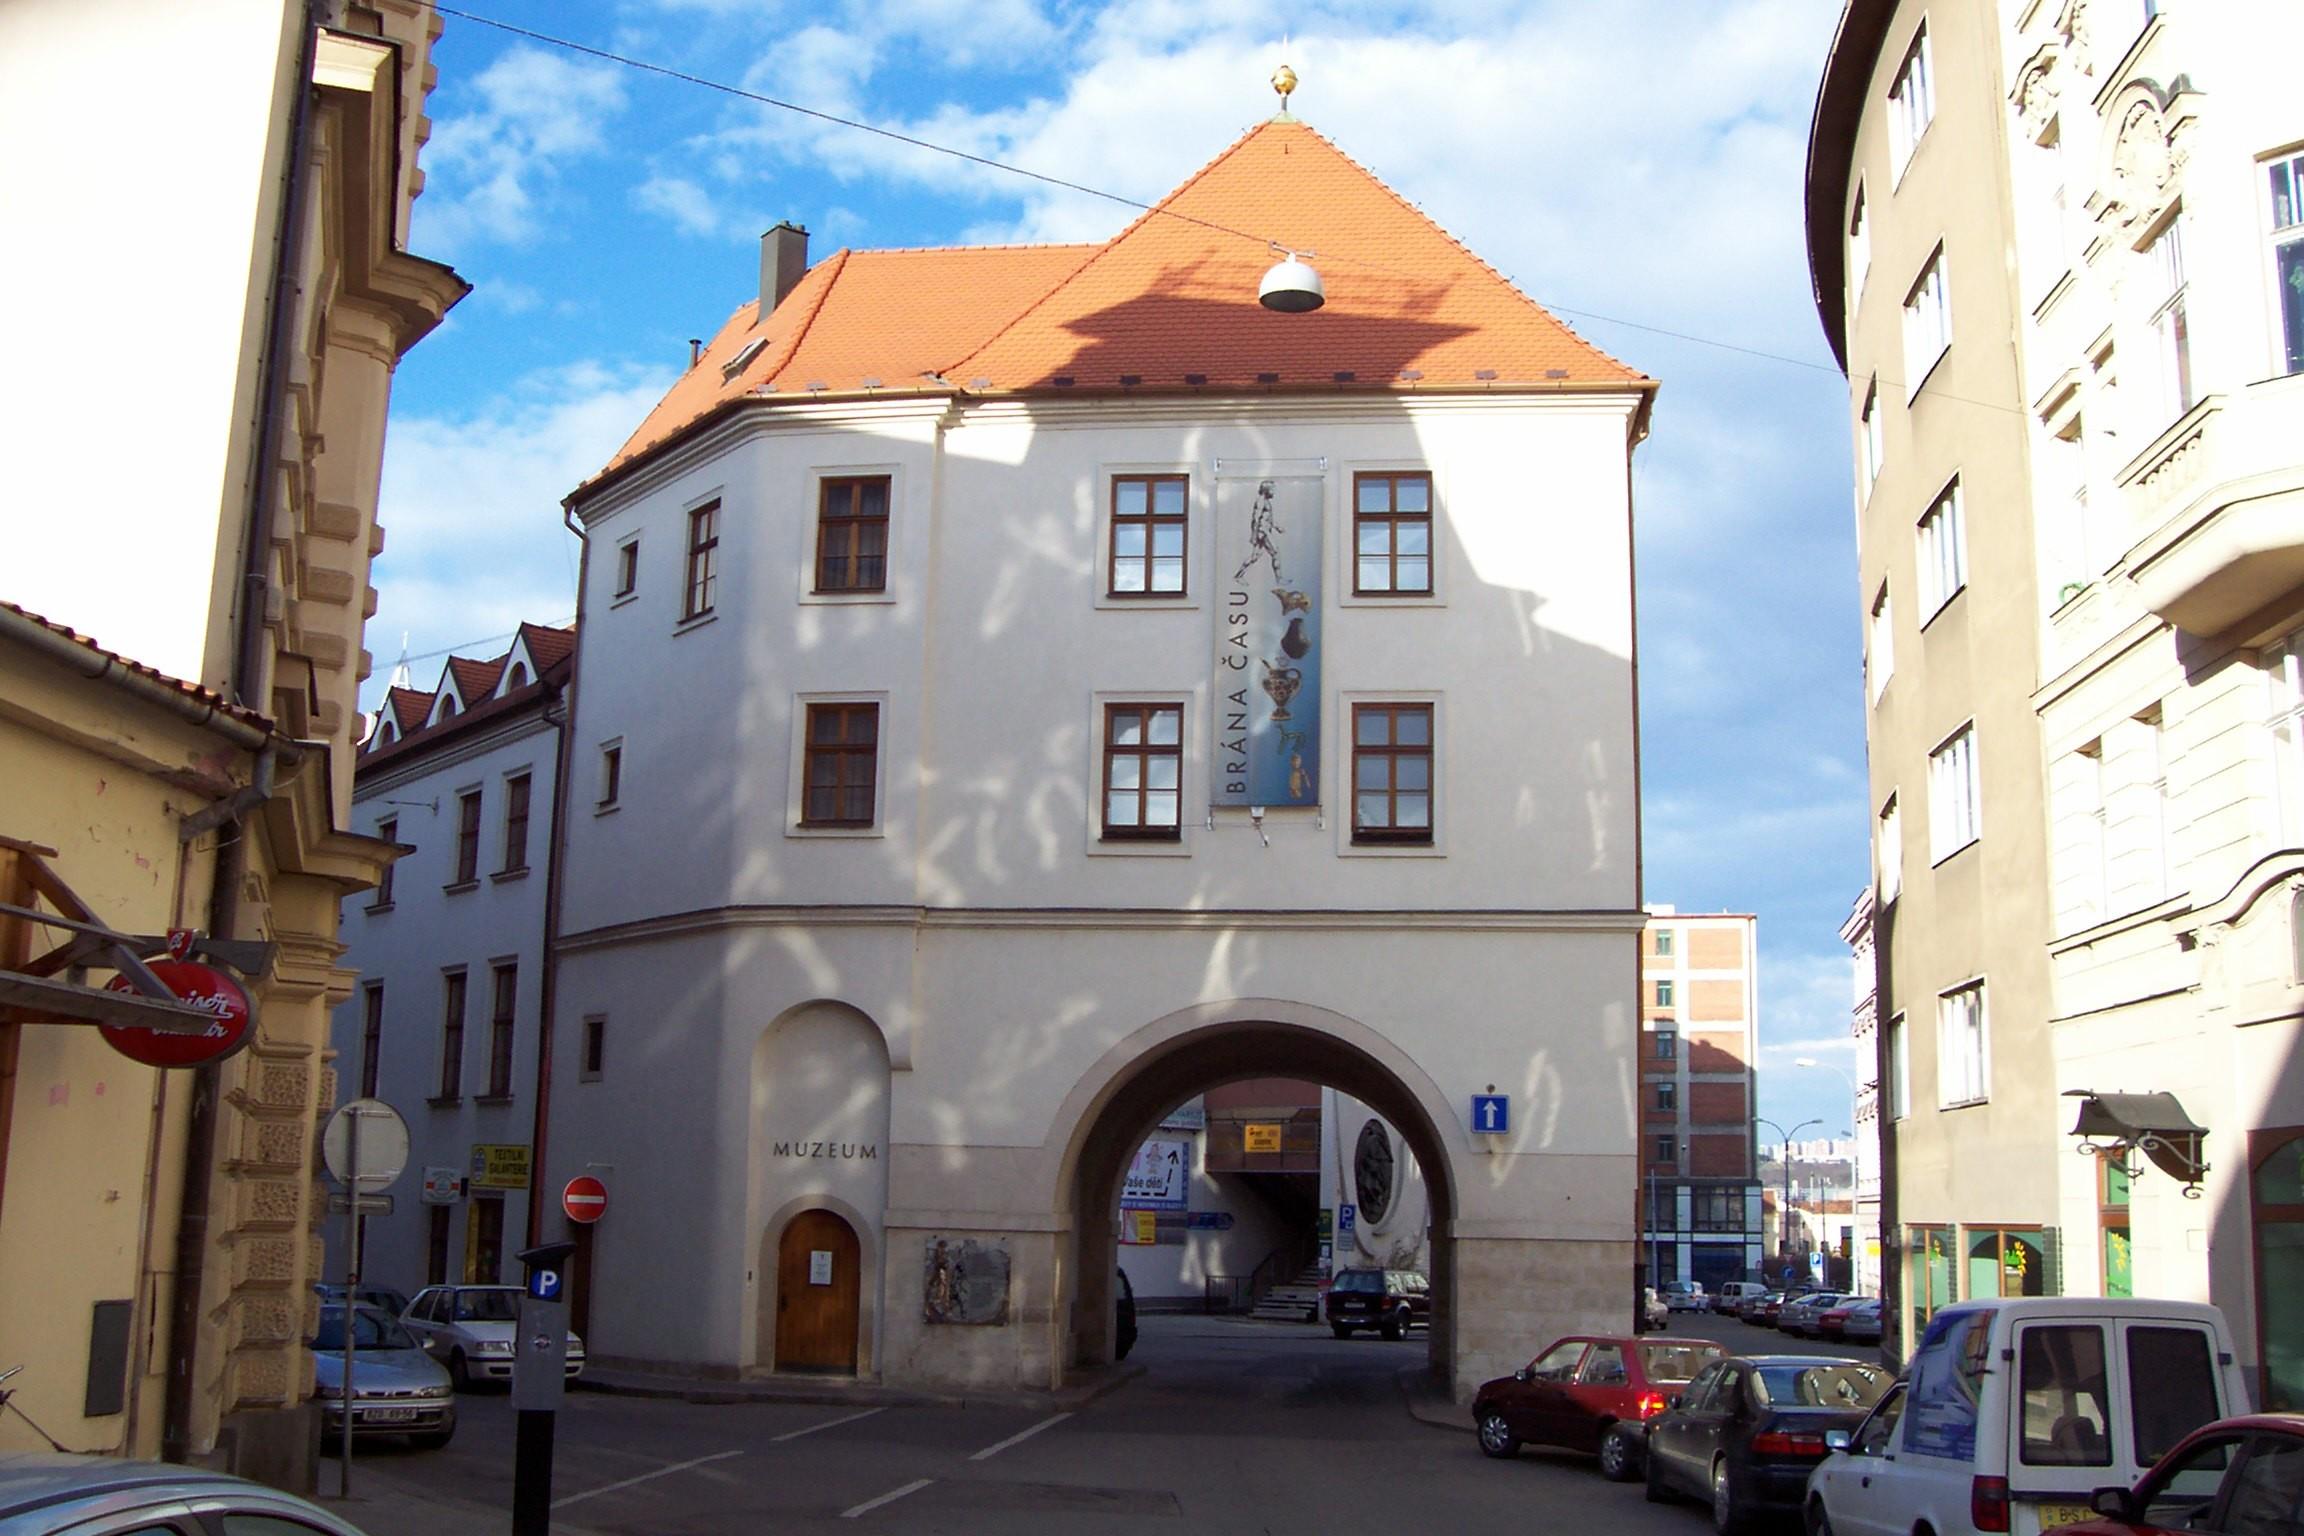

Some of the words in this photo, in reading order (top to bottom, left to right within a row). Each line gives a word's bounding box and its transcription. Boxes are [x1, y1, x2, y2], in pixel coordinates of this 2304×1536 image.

[1221, 591, 1249, 670] ČASU
[1220, 688, 1247, 793] BRÁNA
[773, 1142, 877, 1159] MUZEUM
[539, 1269, 557, 1295] P
